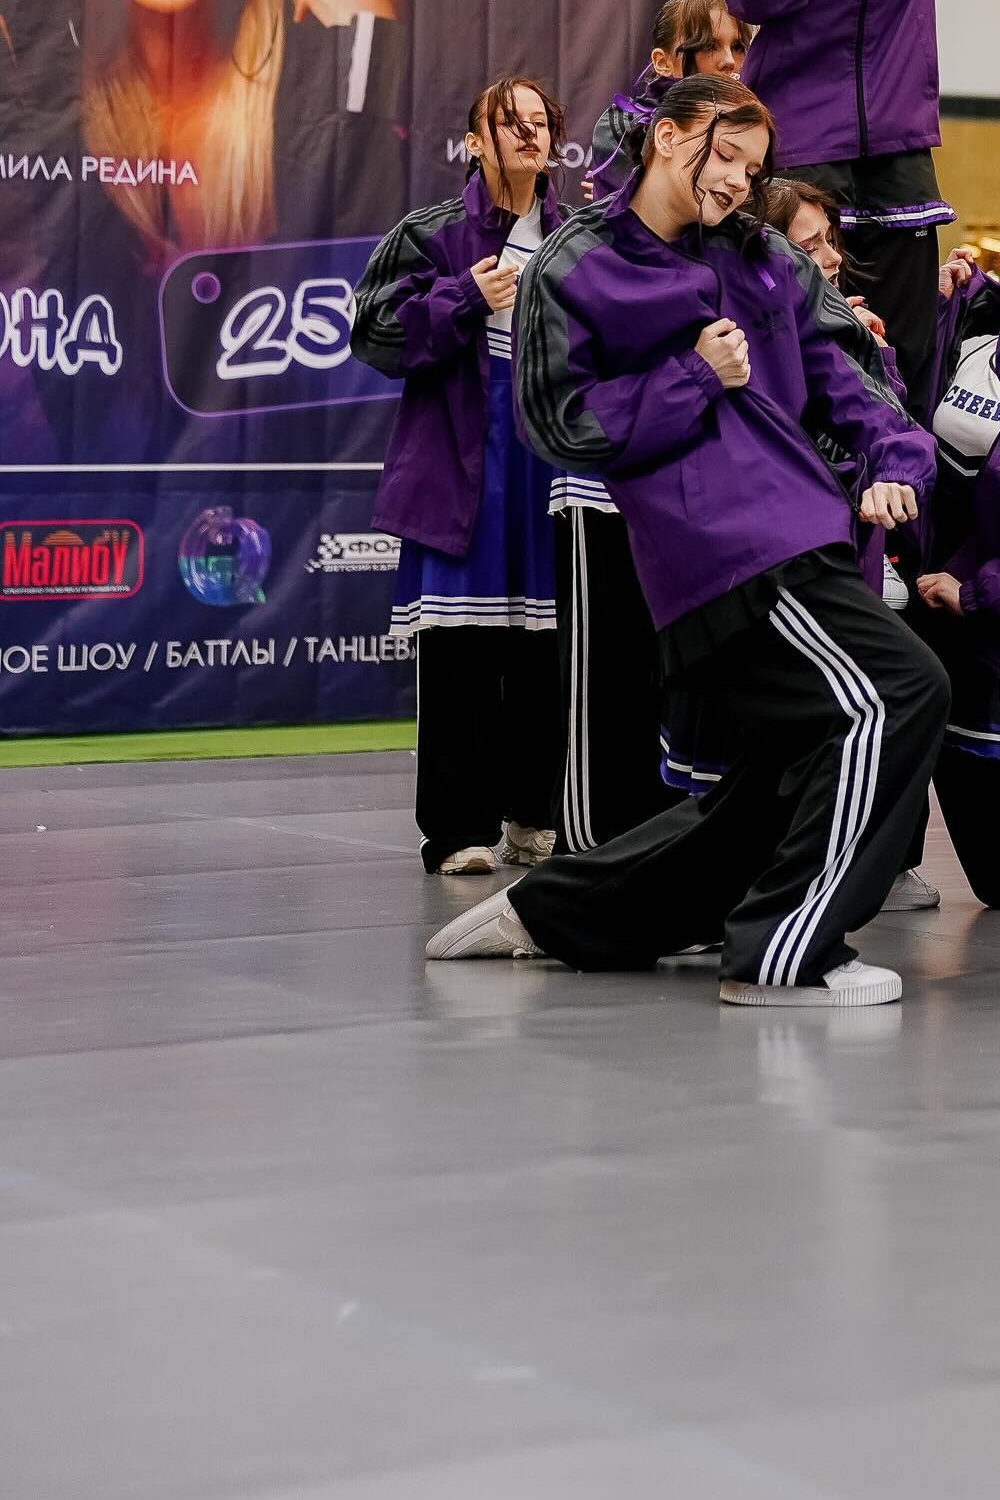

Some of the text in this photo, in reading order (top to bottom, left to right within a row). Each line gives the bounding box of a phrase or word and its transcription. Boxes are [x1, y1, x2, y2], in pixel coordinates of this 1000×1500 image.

[82, 155, 199, 187] РЕДИНА
[0, 286, 123, 376] НА
[216, 278, 357, 380] 25
[0, 645, 49, 674] ОЕ
[57, 642, 137, 671] ШОУ
[166, 637, 275, 667] БАТТЛЫ
[304, 635, 416, 665] ТАНЦЕВ
